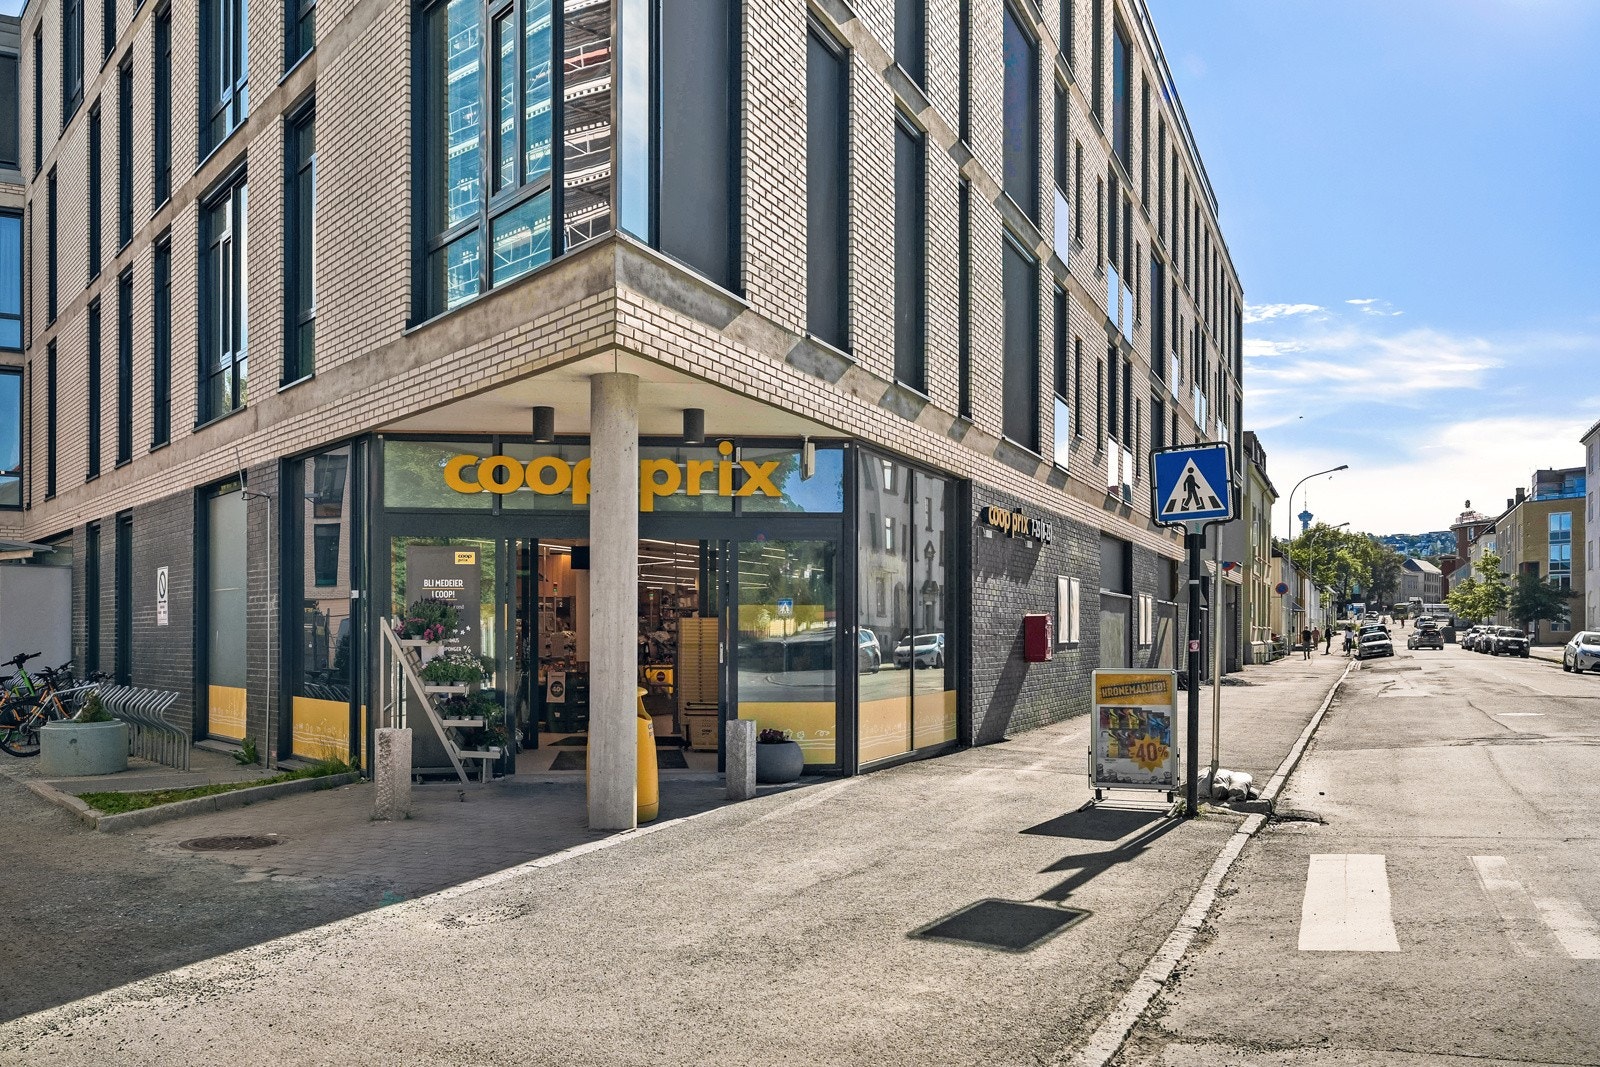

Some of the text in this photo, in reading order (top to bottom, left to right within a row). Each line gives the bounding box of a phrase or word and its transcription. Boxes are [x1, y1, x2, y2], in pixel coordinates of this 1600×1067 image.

[639, 441, 783, 513] prix
[988, 505, 1011, 534] coop
[1012, 508, 1031, 539] prix
[423, 579, 464, 588] BLI MEDEIER
[435, 590, 455, 598] COOP!
